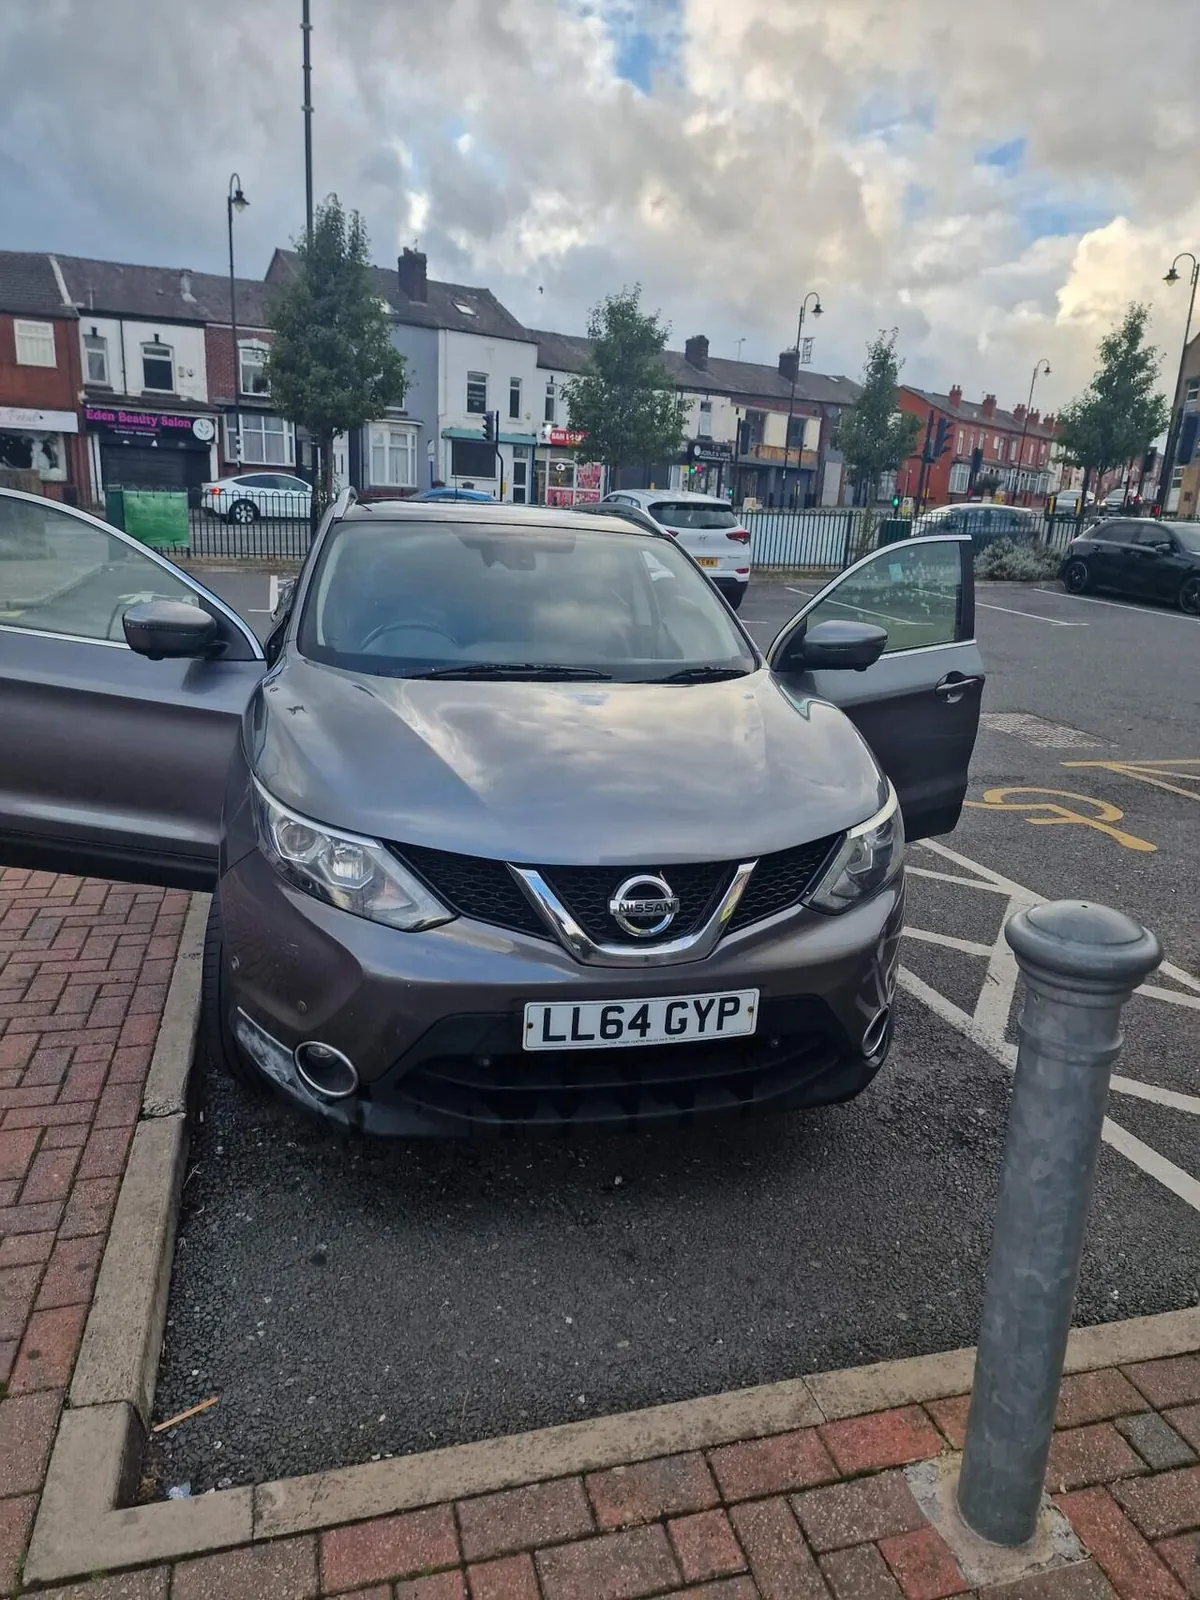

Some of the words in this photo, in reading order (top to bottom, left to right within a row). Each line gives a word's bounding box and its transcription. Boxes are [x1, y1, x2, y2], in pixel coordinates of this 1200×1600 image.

[85, 409, 115, 421] Eden
[118, 412, 158, 427] Beauty
[161, 416, 191, 428] Salon
[618, 902, 673, 913] NISSAN
[542, 1004, 651, 1042] LL64
[664, 996, 741, 1036] GYP
